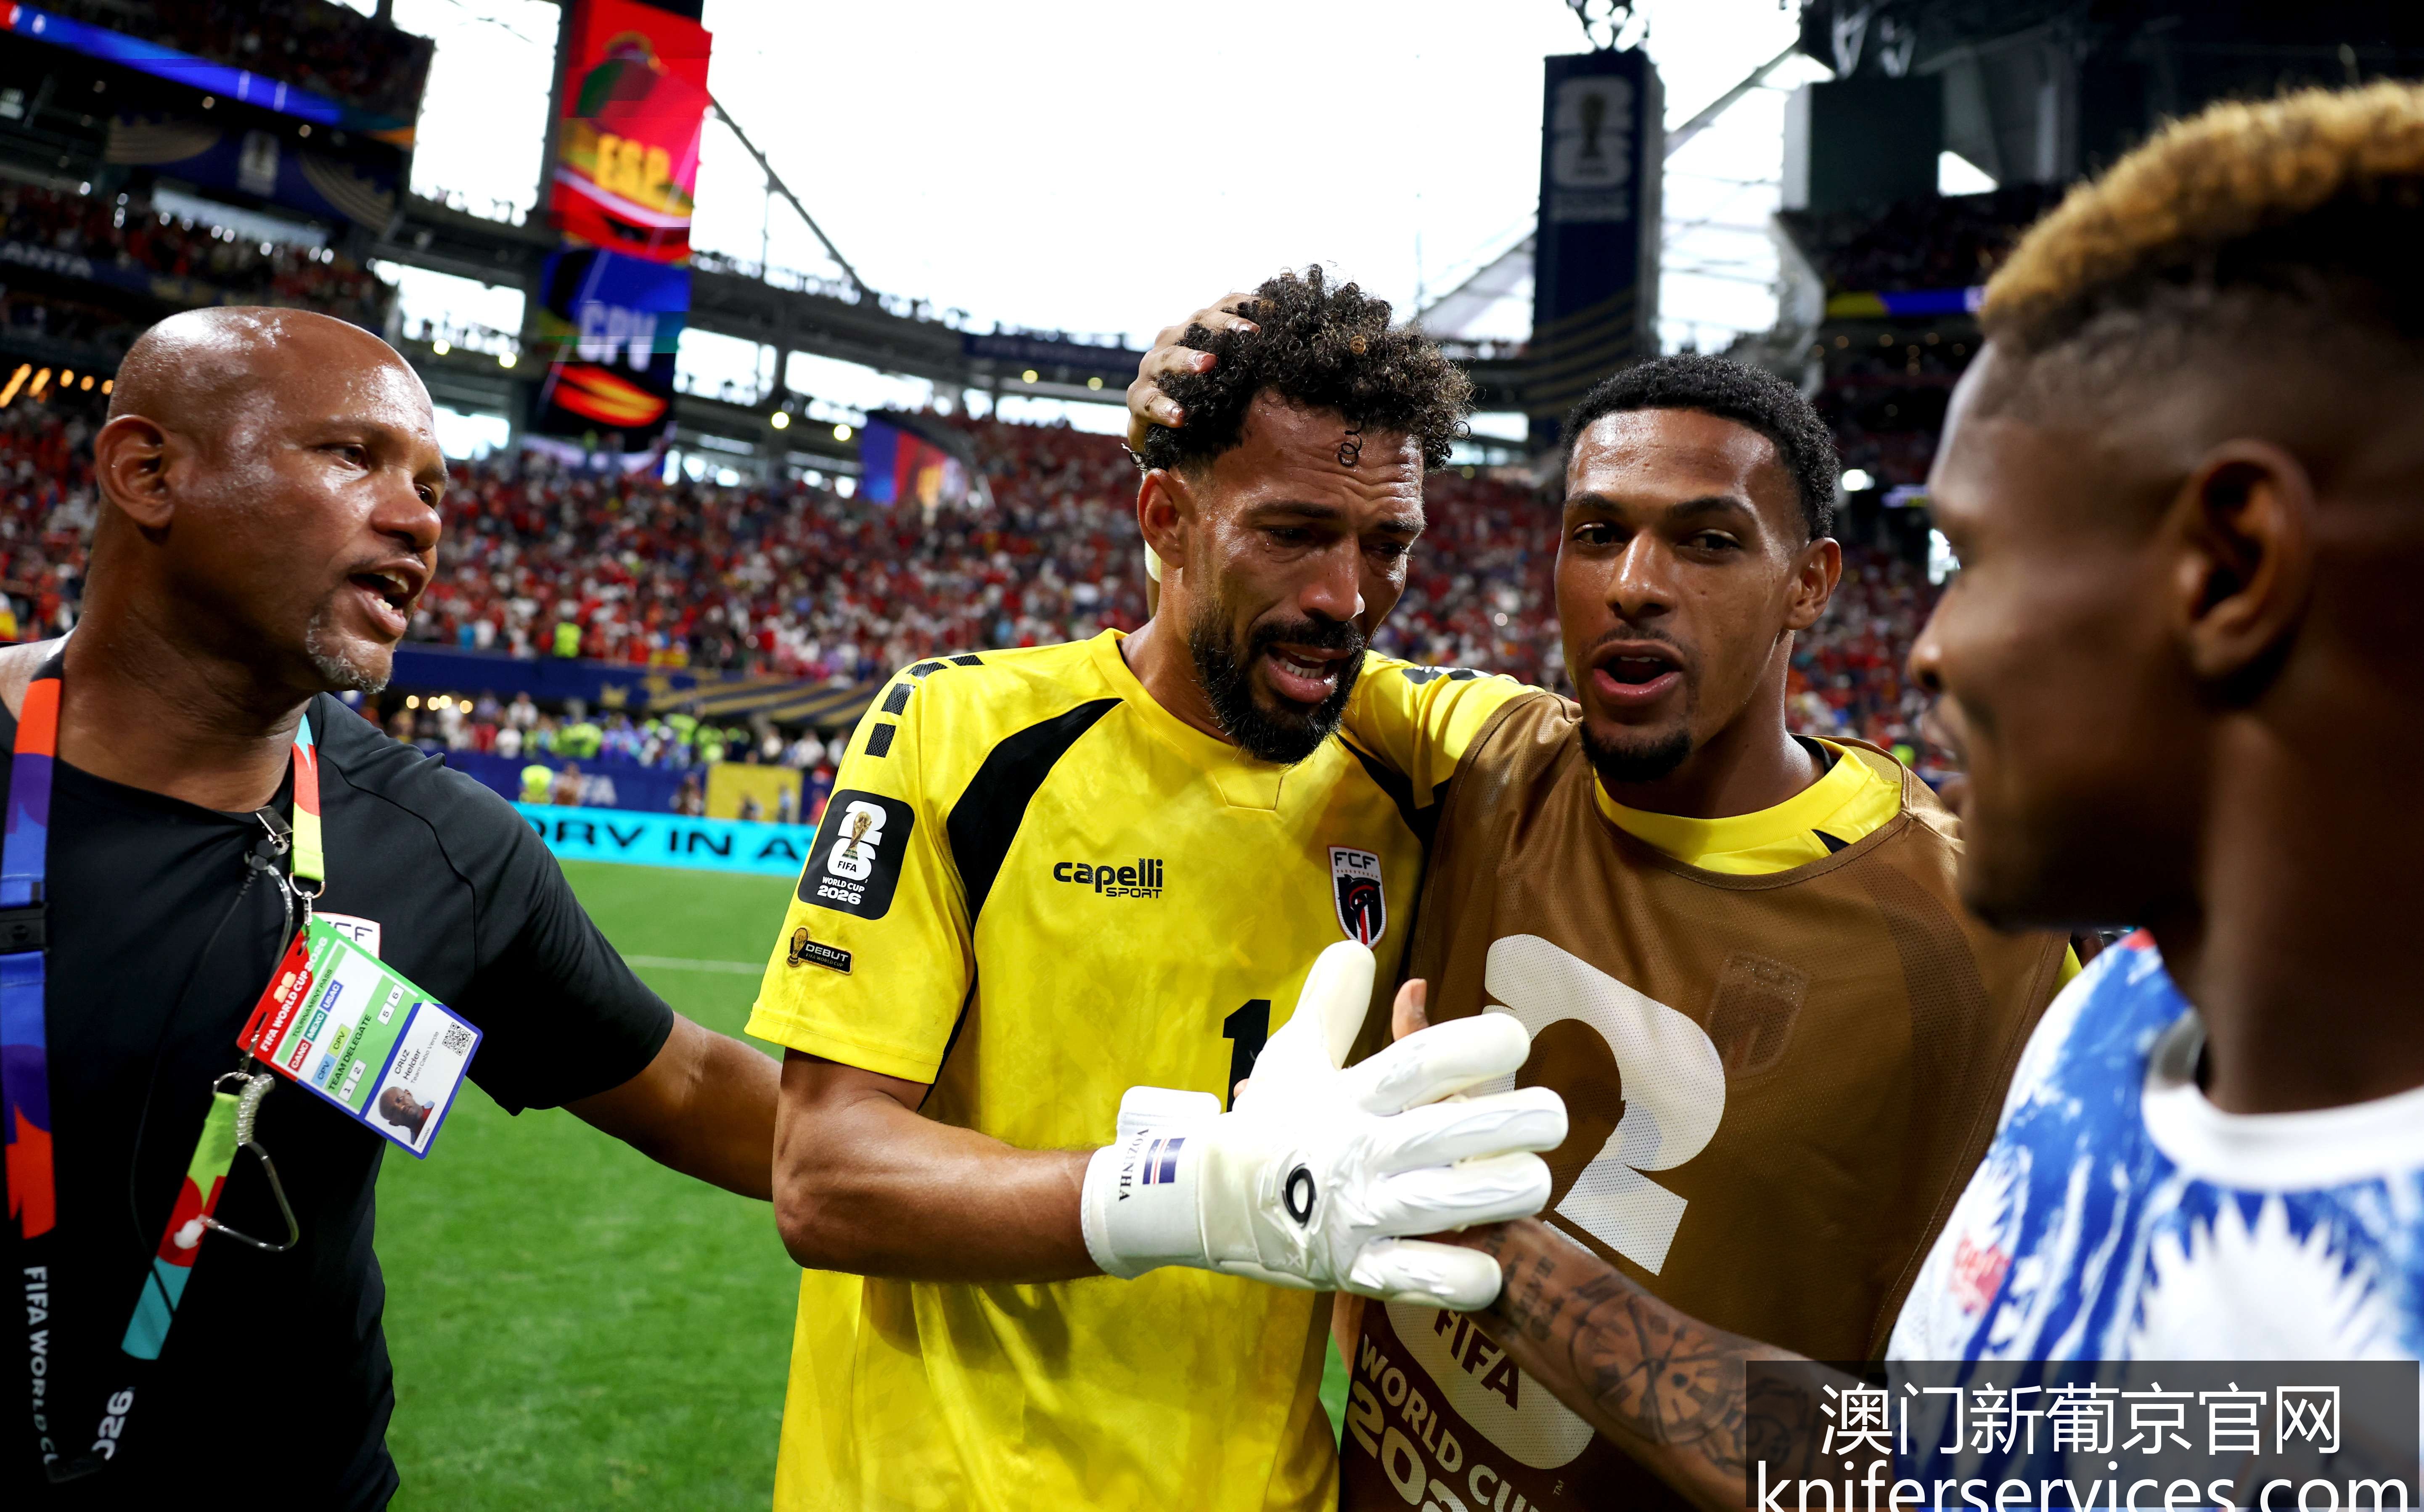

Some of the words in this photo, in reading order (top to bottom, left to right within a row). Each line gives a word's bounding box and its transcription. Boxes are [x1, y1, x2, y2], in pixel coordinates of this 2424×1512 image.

[670, 830, 731, 855] IN
[1334, 851, 1376, 870] FCF
[822, 876, 847, 888] WORLD
[847, 882, 865, 893] CUP
[837, 861, 857, 872] FIFA
[1053, 858, 1163, 893] capelli
[817, 885, 862, 905] 2026
[1106, 887, 1163, 899] SPORT
[805, 944, 849, 962] DEBUT
[816, 955, 834, 965] WORLD
[259, 1028, 279, 1052] FIFA
[273, 989, 298, 1028] WORLD
[293, 970, 309, 992] CUP
[304, 936, 328, 972] 2026
[292, 988, 321, 1037] TOURNAMENT
[320, 969, 333, 989] PASS
[318, 1061, 330, 1080] CPV
[333, 1031, 345, 1050] CPV
[328, 1063, 347, 1090] TEAM
[343, 1014, 372, 1063] DELEGATE
[394, 1049, 410, 1074] CRUZ
[402, 1048, 422, 1080] Helder
[410, 1067, 422, 1084] Team
[419, 1049, 430, 1067] Cabo
[427, 1031, 439, 1049] Verde
[1222, 999, 1271, 1113] 1
[24, 1266, 49, 1326] FIFA
[29, 1329, 50, 1432] WORLD
[1434, 1309, 1520, 1411] FIFA
[91, 1390, 134, 1461] 026
[1360, 1334, 1463, 1472] WORLD
[1468, 1464, 1540, 1512] CU
